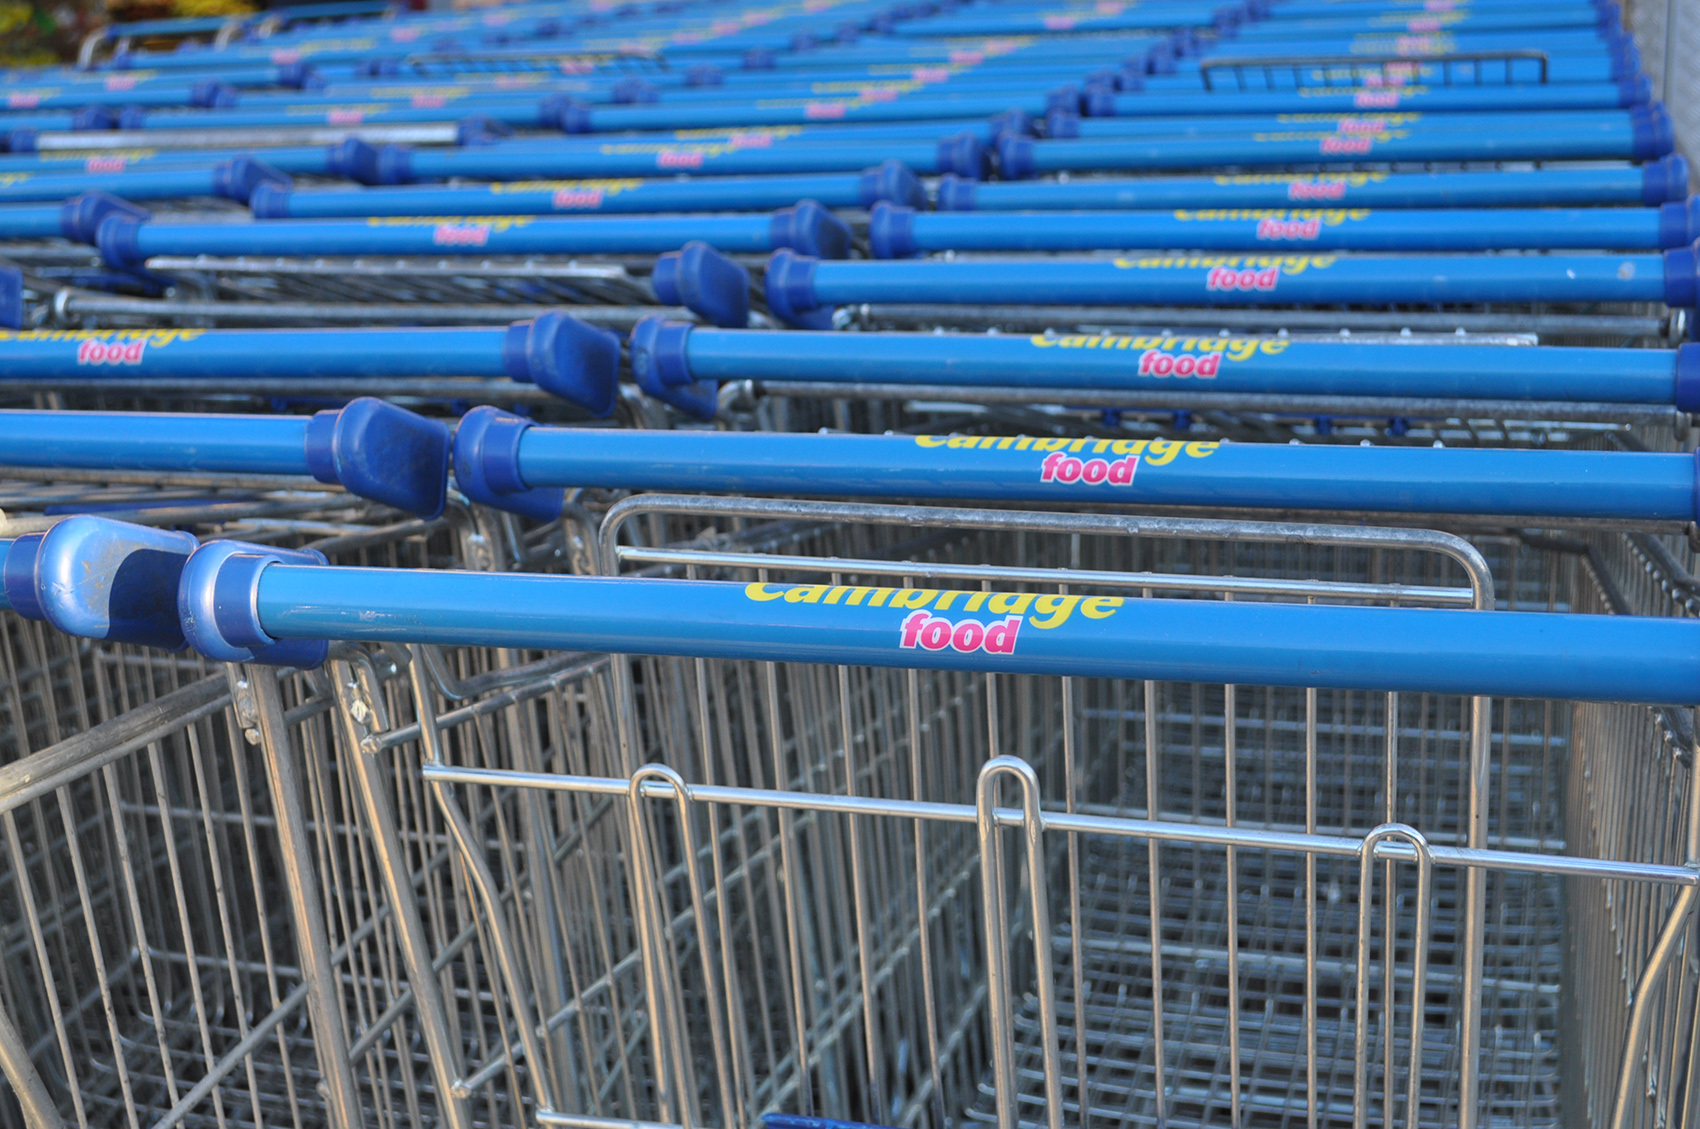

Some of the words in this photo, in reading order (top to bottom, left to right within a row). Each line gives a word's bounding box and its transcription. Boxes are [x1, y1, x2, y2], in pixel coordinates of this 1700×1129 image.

[1256, 217, 1321, 240] food
[1206, 266, 1280, 291] food
[77, 338, 147, 365] food
[1138, 350, 1222, 378] food
[1040, 452, 1139, 486] food
[744, 582, 1124, 629] Cambridge
[900, 609, 1023, 655] food
